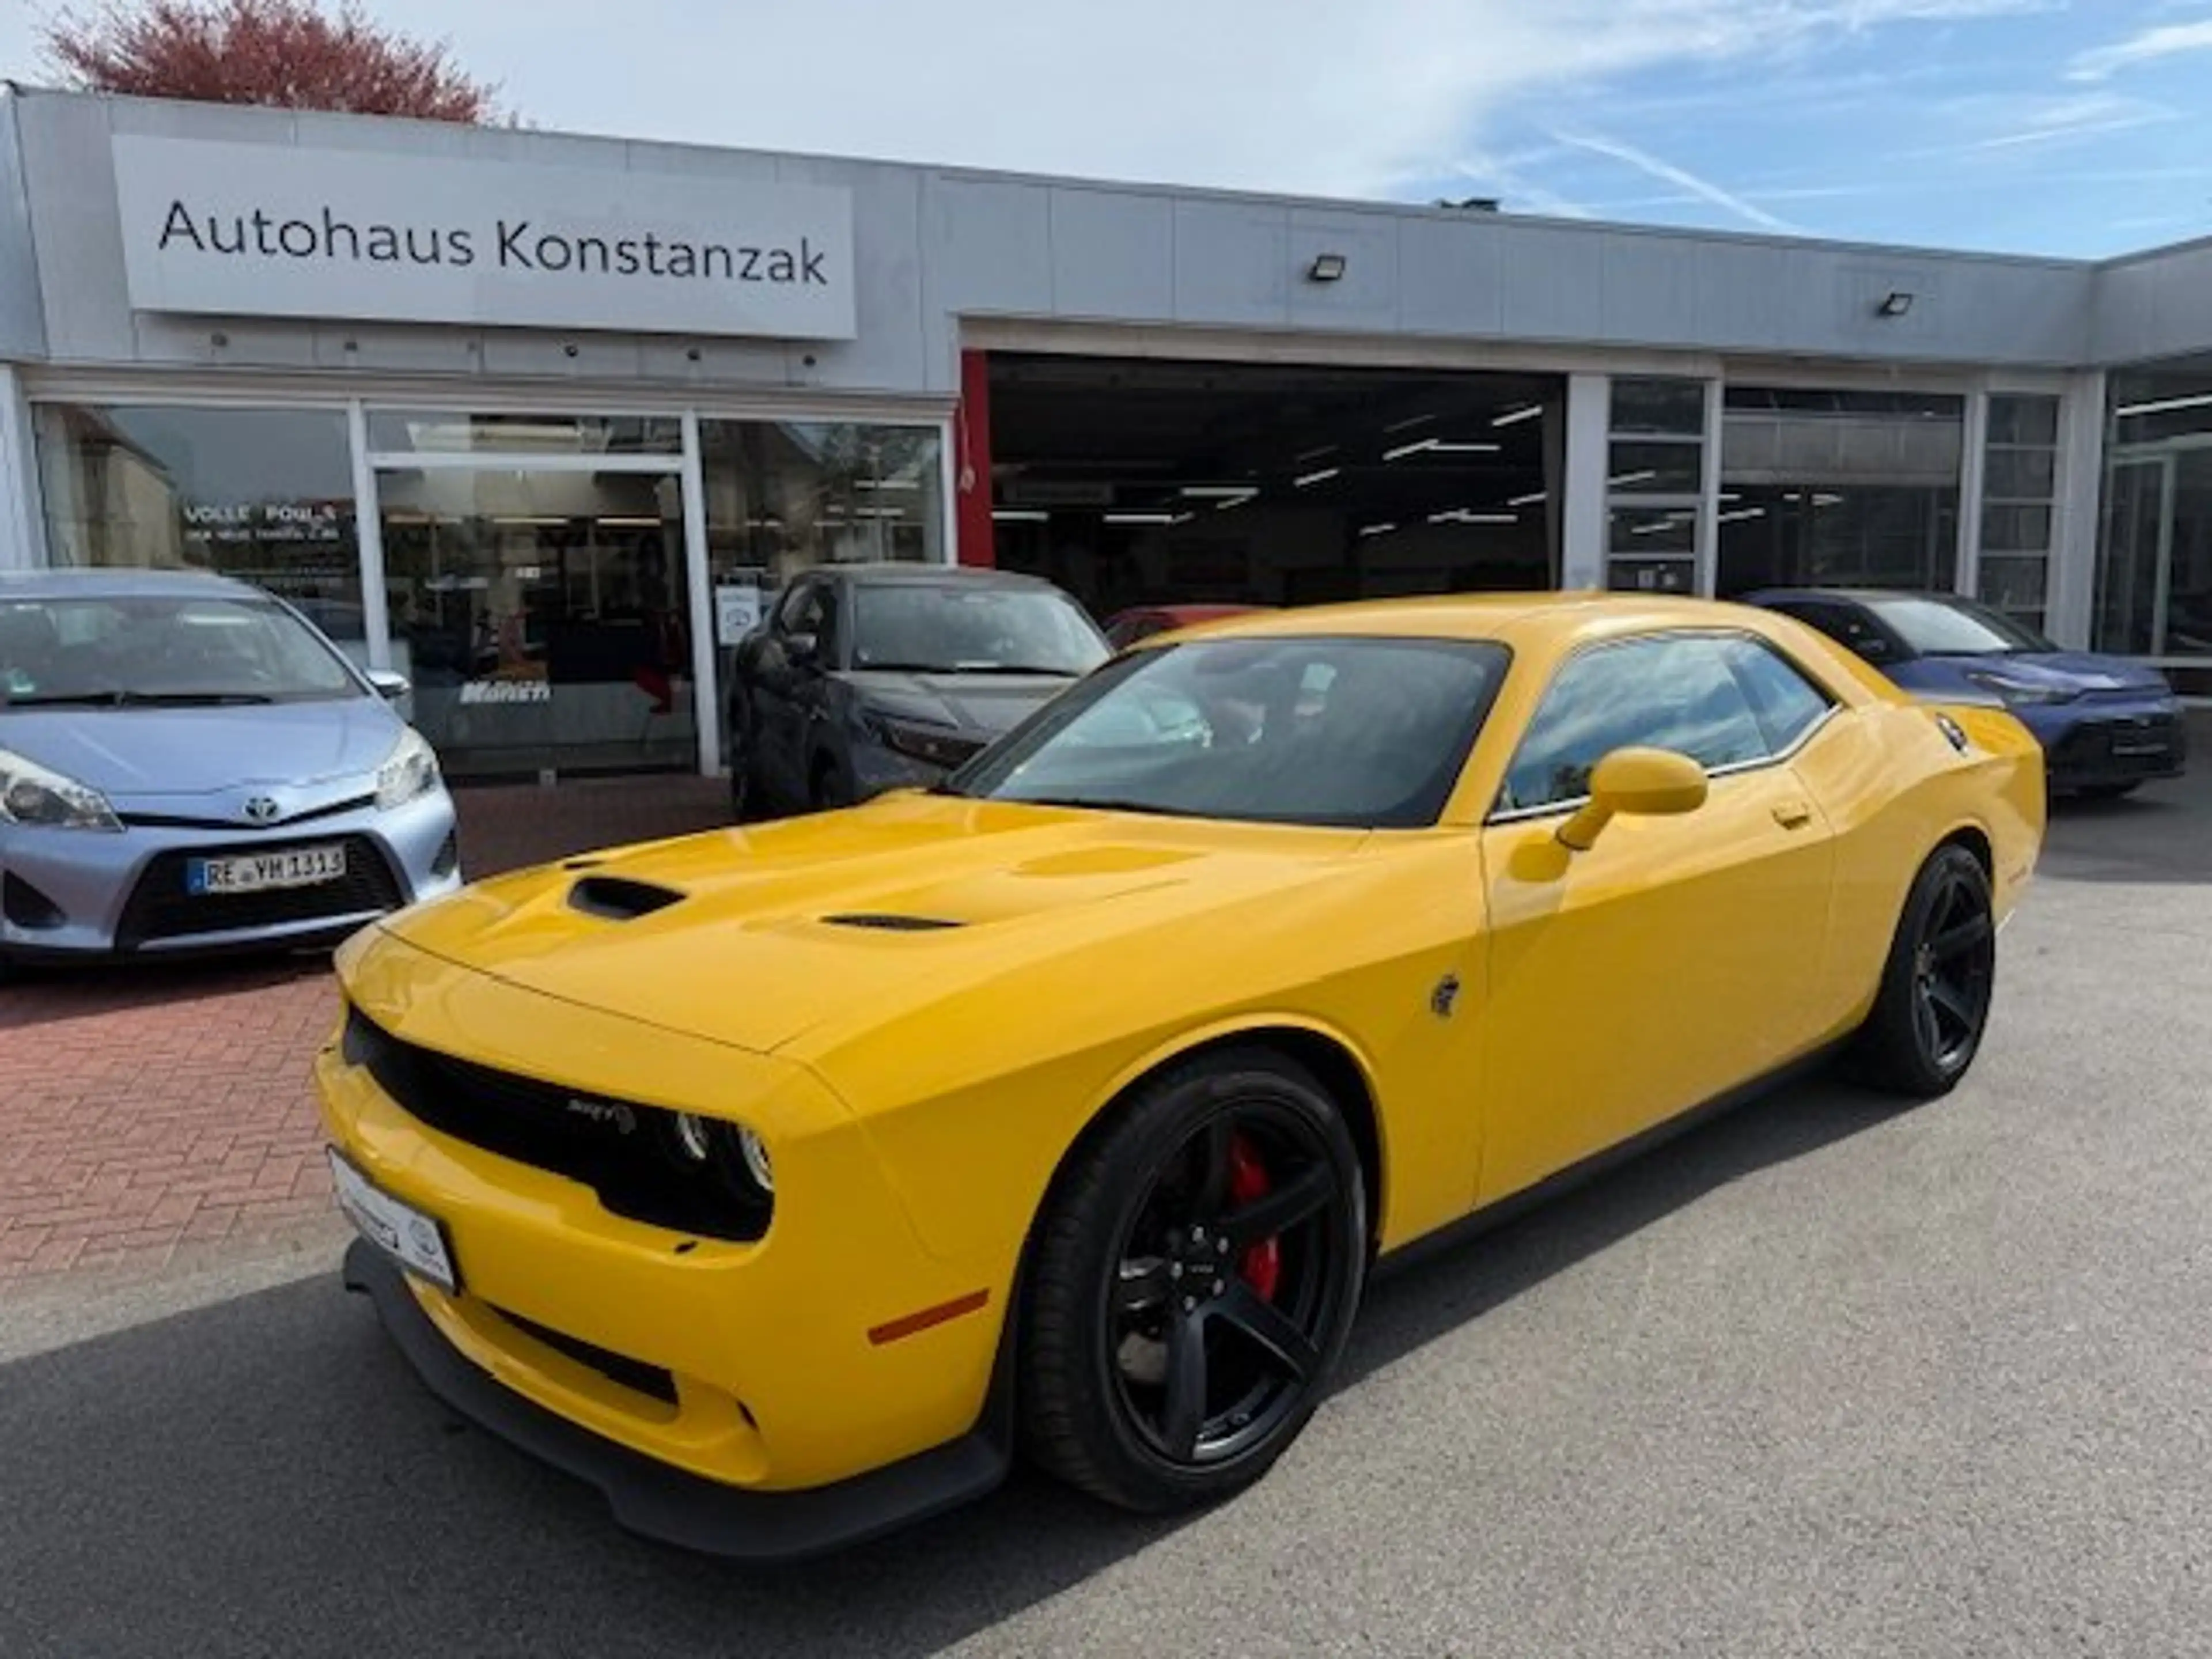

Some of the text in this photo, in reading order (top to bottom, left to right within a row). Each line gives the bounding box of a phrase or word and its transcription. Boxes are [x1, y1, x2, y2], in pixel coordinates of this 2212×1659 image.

[158, 199, 828, 285] Autohaus Konstanzak
[207, 862, 236, 886] RE
